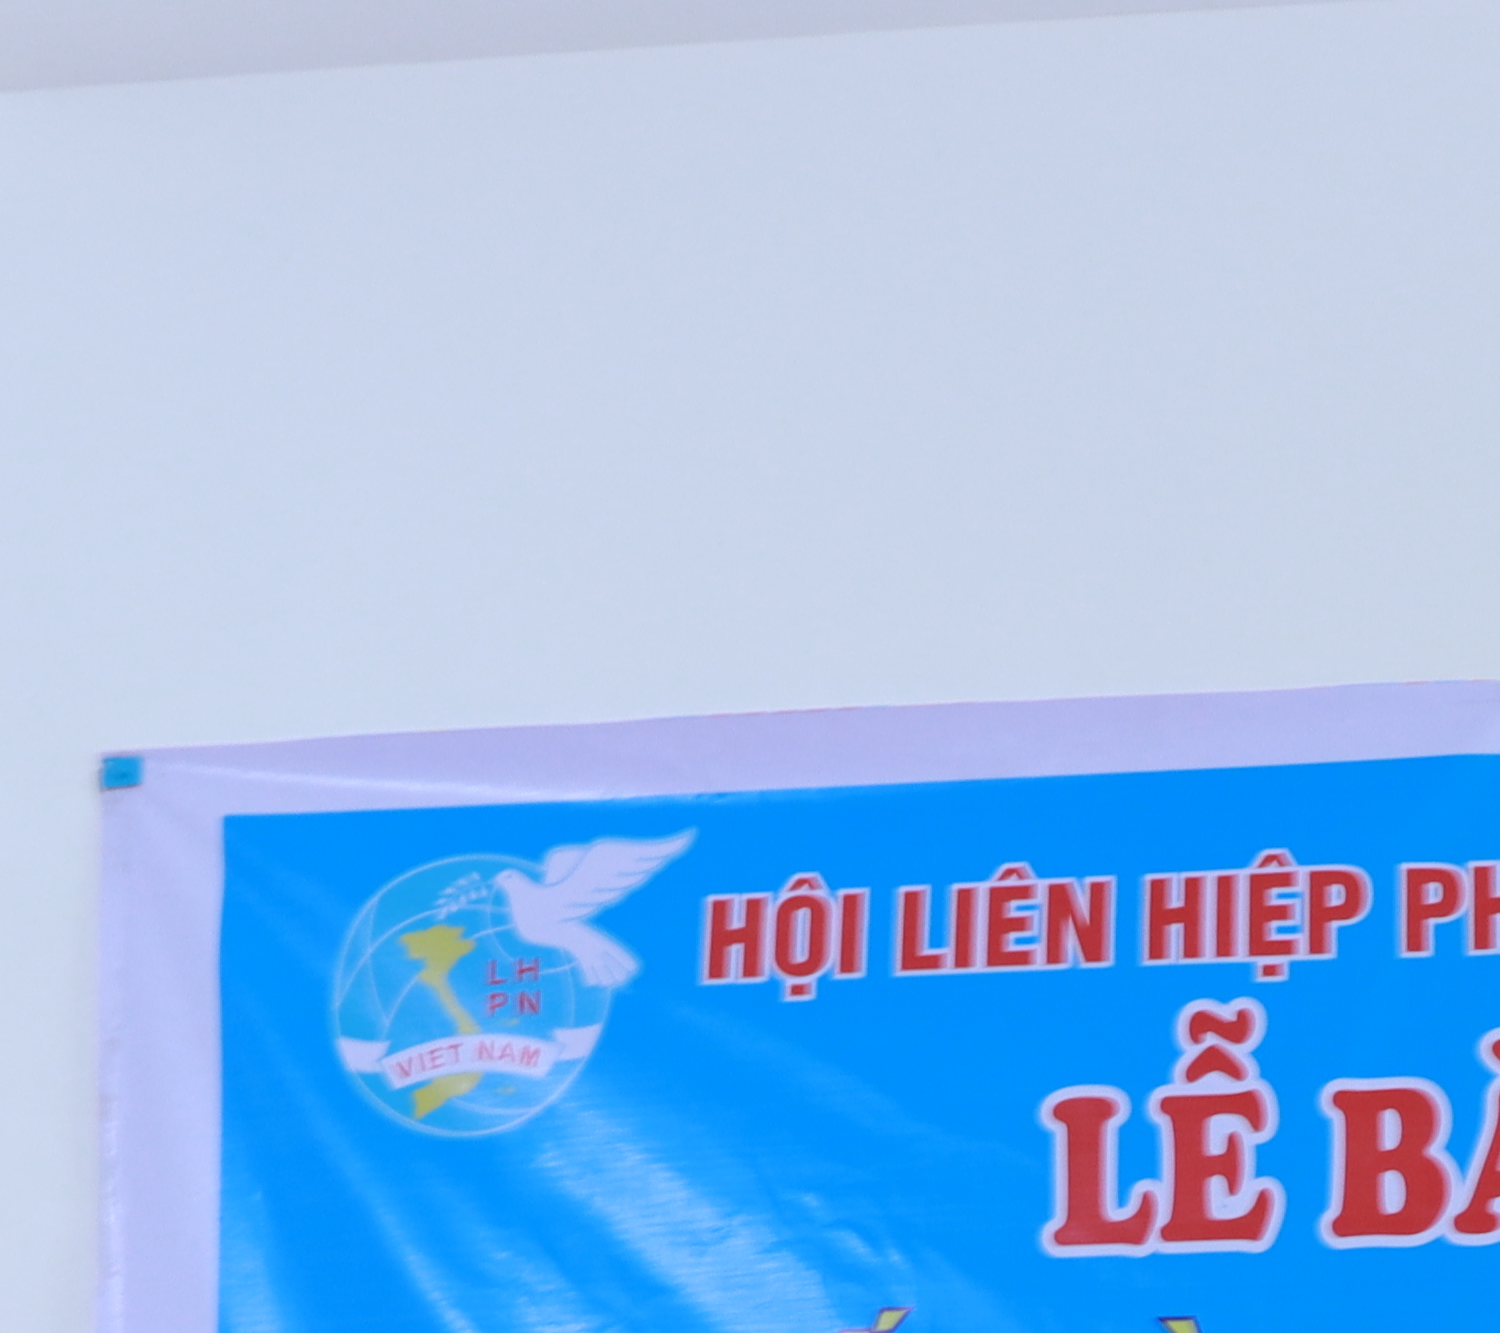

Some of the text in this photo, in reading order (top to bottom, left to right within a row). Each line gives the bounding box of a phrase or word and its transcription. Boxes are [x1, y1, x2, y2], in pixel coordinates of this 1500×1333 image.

[702, 873, 869, 1000] HỘI
[894, 865, 1114, 977] LIÊN
[1145, 852, 1370, 979] HIỆP
[1041, 998, 1280, 1258] LỄ
